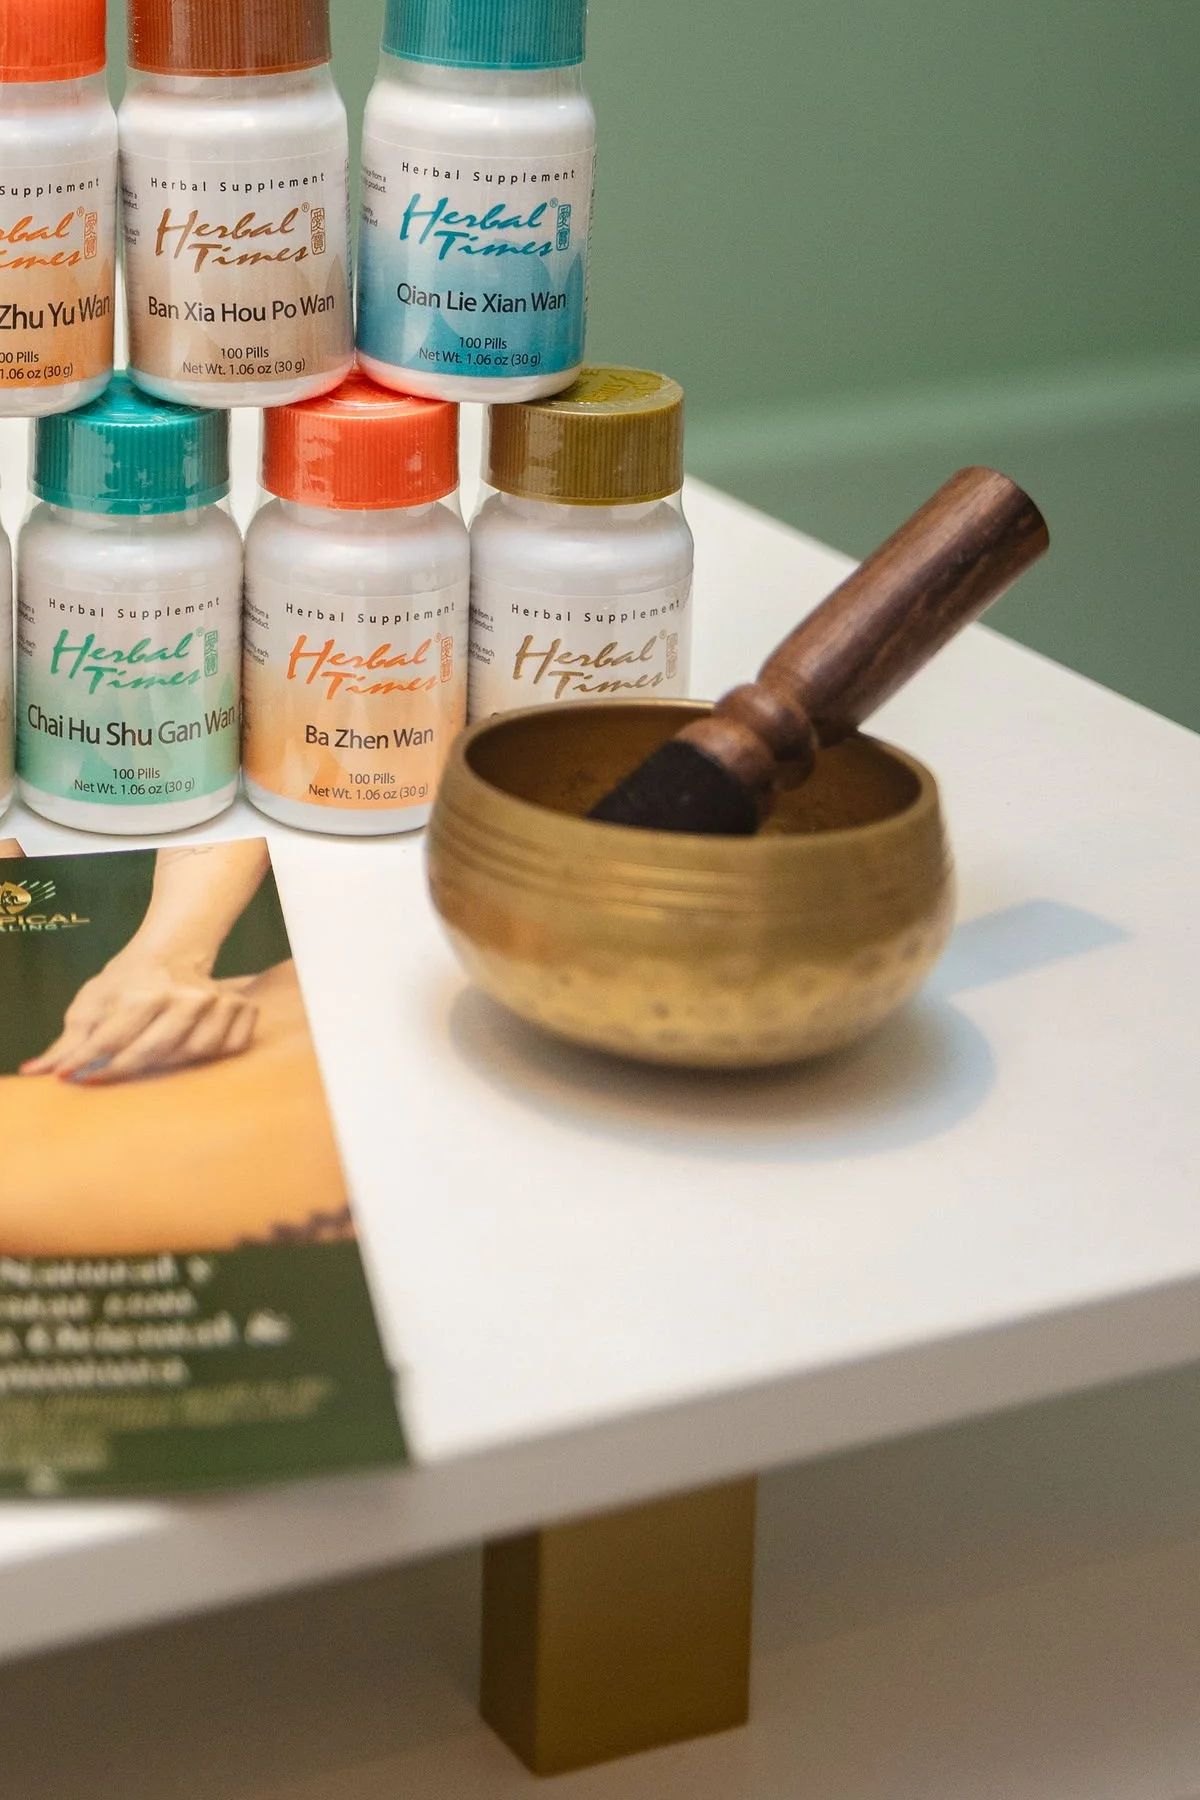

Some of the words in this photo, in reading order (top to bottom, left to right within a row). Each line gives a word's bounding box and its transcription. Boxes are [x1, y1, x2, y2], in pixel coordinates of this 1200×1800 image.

[151, 178, 206, 191] Herbal
[220, 173, 324, 193] Supplement
[402, 162, 460, 180] Herbal
[474, 170, 575, 184] Supplement
[0, 178, 99, 198] Supplement
[400, 193, 547, 244] Herbal
[155, 207, 299, 258] Herbal
[188, 243, 309, 272] Times
[434, 231, 552, 261] Times
[149, 296, 179, 319] Ban
[184, 301, 214, 321] Xia
[222, 303, 265, 322] Hou
[273, 301, 296, 319] Po
[300, 295, 334, 314] Wan
[397, 283, 440, 308] Qian
[447, 291, 476, 311] Lie
[483, 293, 526, 313] Xian
[531, 292, 566, 310] Wan
[49, 302, 74, 326] Yu
[79, 295, 110, 321] Wan
[221, 348, 242, 359] 100
[246, 347, 269, 359] Pills
[460, 337, 481, 349] 100
[485, 338, 507, 350] Pills
[17, 351, 39, 363] Pills
[183, 361, 203, 374] Net
[206, 364, 226, 375] Wt.
[230, 364, 254, 374] 1.06
[257, 365, 271, 373] oz
[275, 361, 292, 373] (30
[295, 359, 305, 373] g)
[419, 347, 440, 361] Net
[443, 351, 462, 363] Wt.
[467, 354, 491, 364] 1.06
[495, 357, 508, 365] oz
[511, 354, 528, 366] (30
[531, 352, 541, 365] g)
[0, 368, 23, 379] 1.06
[27, 370, 40, 378] oz
[44, 366, 61, 379] (30
[63, 363, 73, 377] g)
[49, 598, 104, 618] Herbal
[118, 598, 219, 620] Supplement
[286, 603, 344, 622] Herbal
[358, 603, 454, 624] Supplement
[512, 604, 570, 621] Herbal
[584, 600, 679, 623] Supplement
[50, 629, 193, 679] Herbal
[287, 635, 432, 684] Herbal
[513, 635, 657, 684] Herbal
[84, 666, 200, 694] Times
[321, 671, 436, 699] Times
[550, 671, 663, 699] Times
[28, 705, 63, 738] Chai
[69, 719, 99, 744] Hu
[106, 722, 152, 746] Shu
[158, 720, 200, 743] Gan
[205, 706, 234, 734] Wan
[306, 725, 329, 746] Ba
[335, 729, 388, 749] Zhen
[393, 728, 433, 748] Wan
[113, 768, 134, 779] 100
[138, 768, 160, 779] Pills
[349, 773, 369, 784] 100
[374, 774, 395, 784] Pills
[74, 780, 94, 793] Net
[97, 783, 117, 794] Wt.
[121, 784, 145, 794] 1.06
[149, 786, 162, 794] oz
[165, 781, 182, 794] (30
[185, 779, 195, 791] g)
[309, 784, 329, 797] Net
[332, 788, 351, 799] Wt.
[357, 789, 380, 800] 1.06
[383, 791, 396, 799] oz
[400, 786, 416, 800] (30
[419, 784, 428, 798] g)
